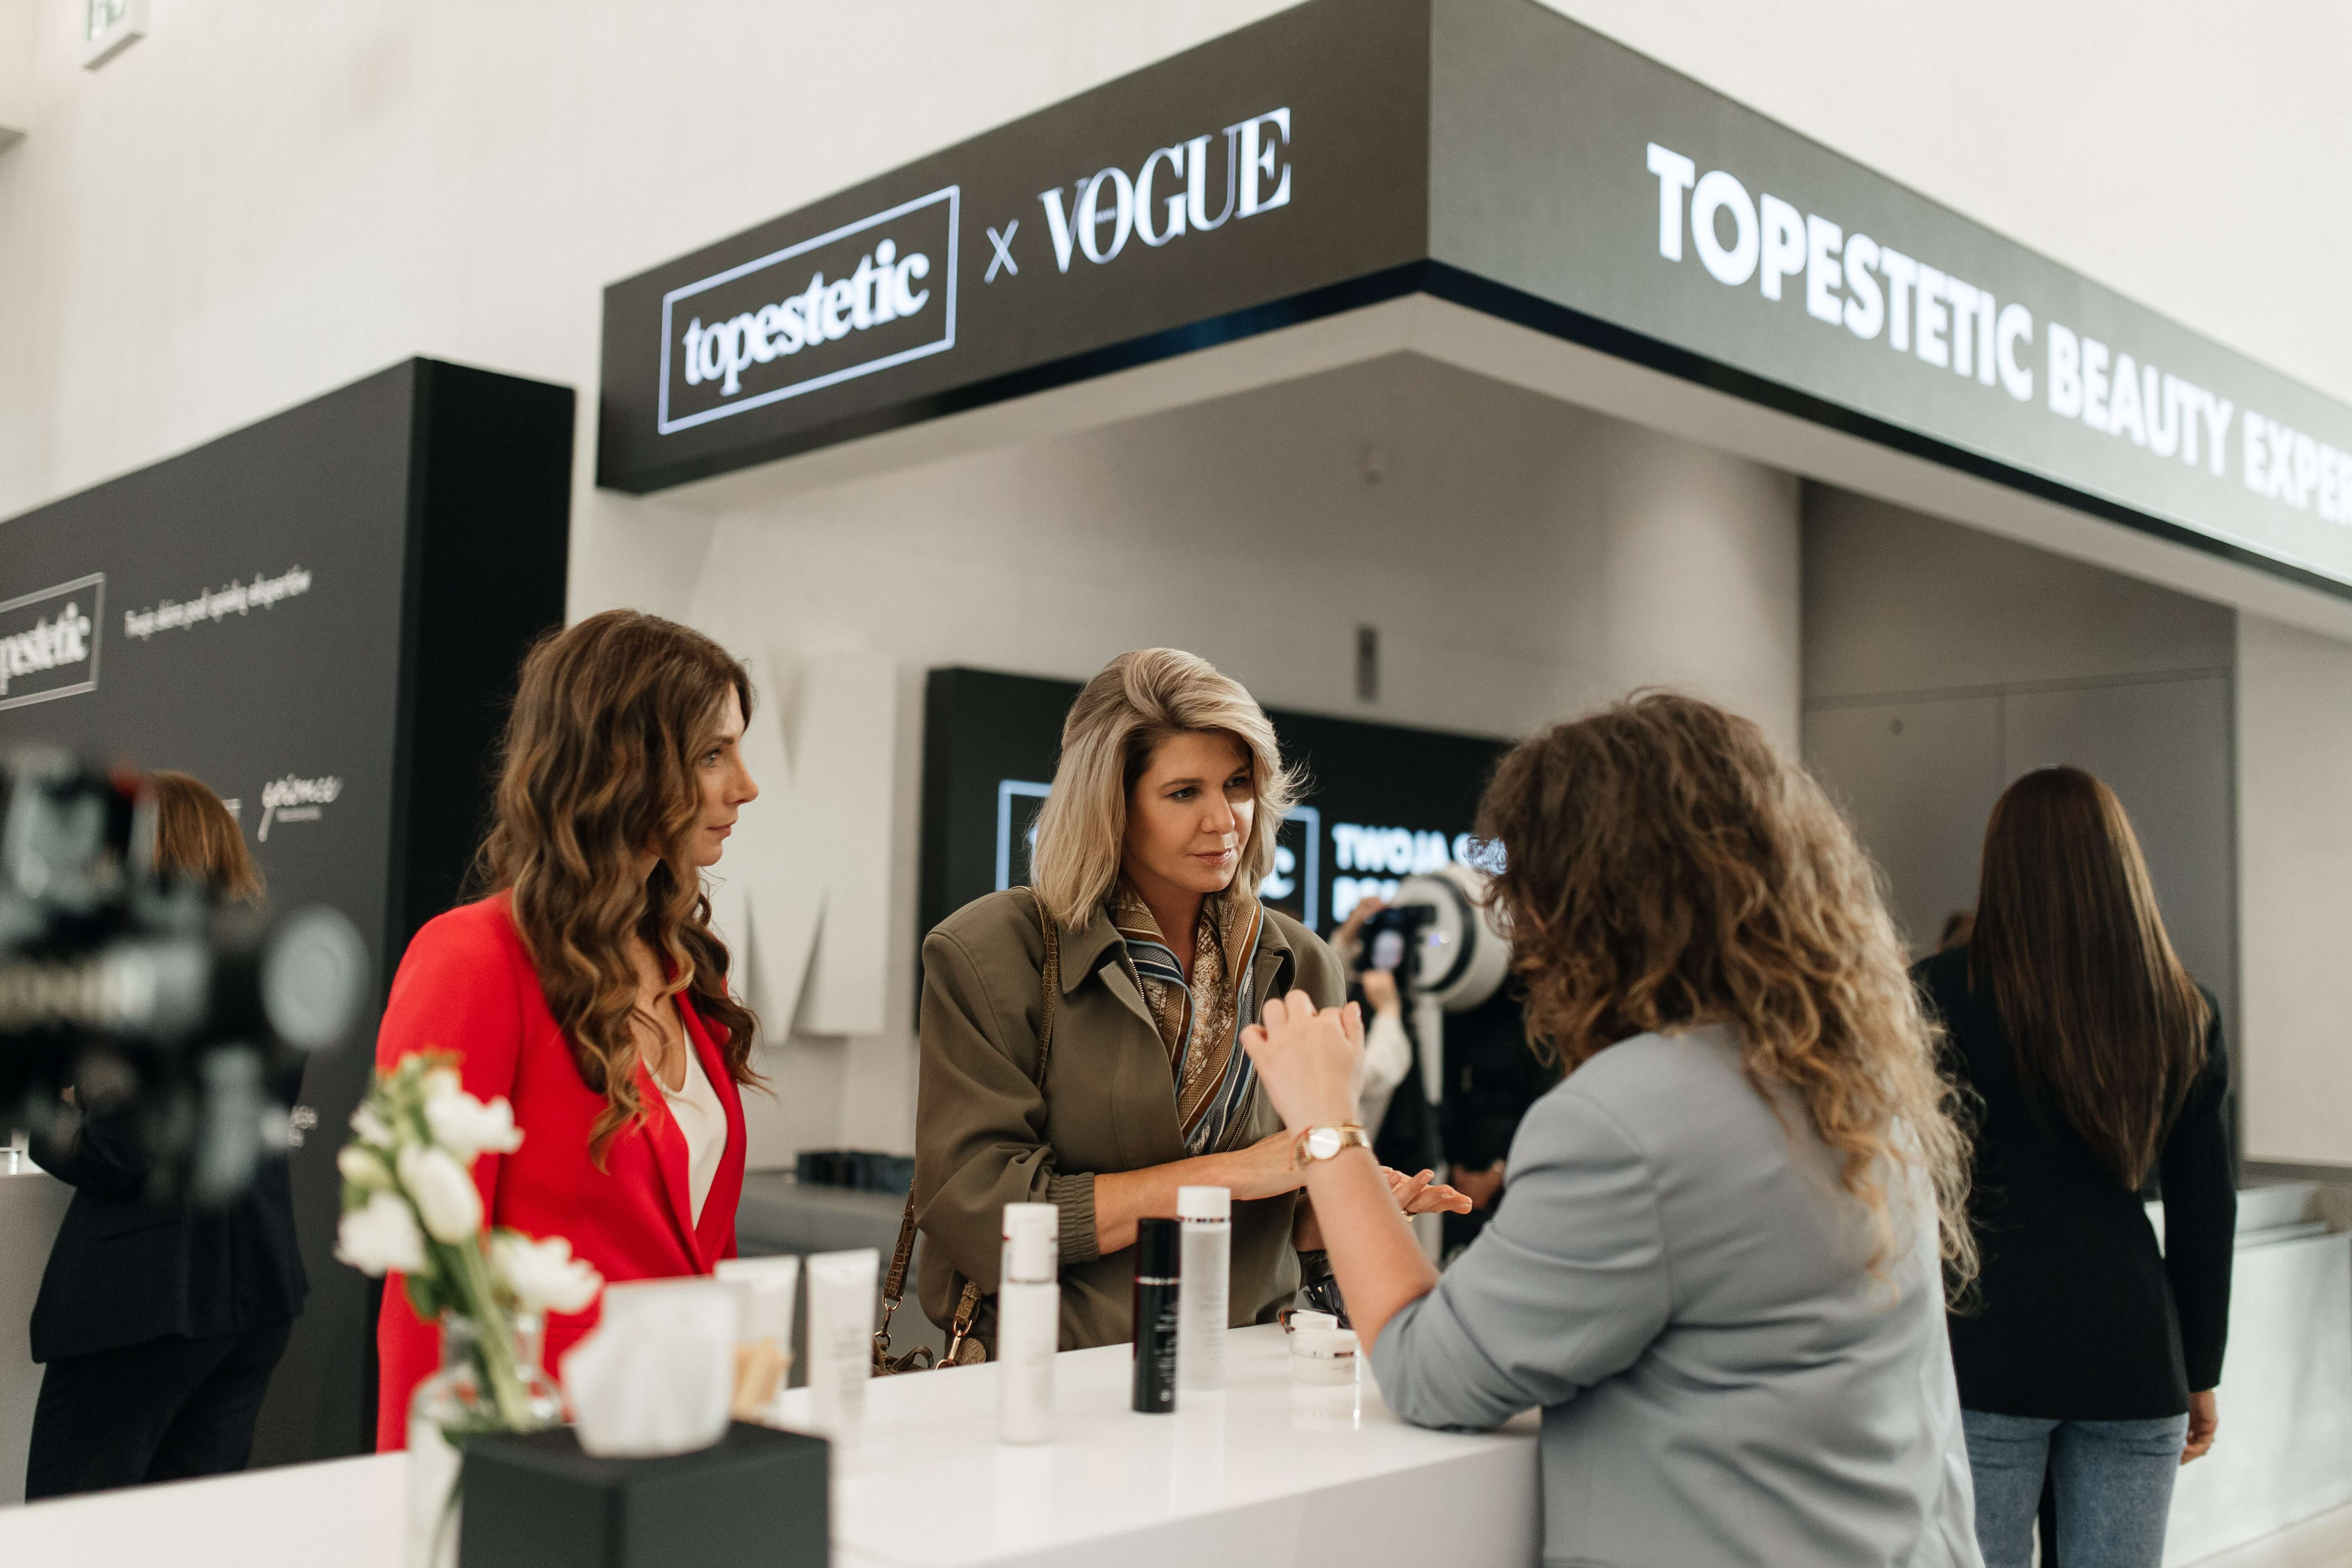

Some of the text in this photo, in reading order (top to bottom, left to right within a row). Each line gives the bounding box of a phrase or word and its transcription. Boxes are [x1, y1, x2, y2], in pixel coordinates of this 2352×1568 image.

[682, 238, 930, 396] topestetic
[1036, 106, 1292, 274] VOGUE
[1647, 142, 2034, 403] TOPESTETIC
[2047, 320, 2234, 479] BEAUTY
[1331, 822, 1451, 876] TWOJA
